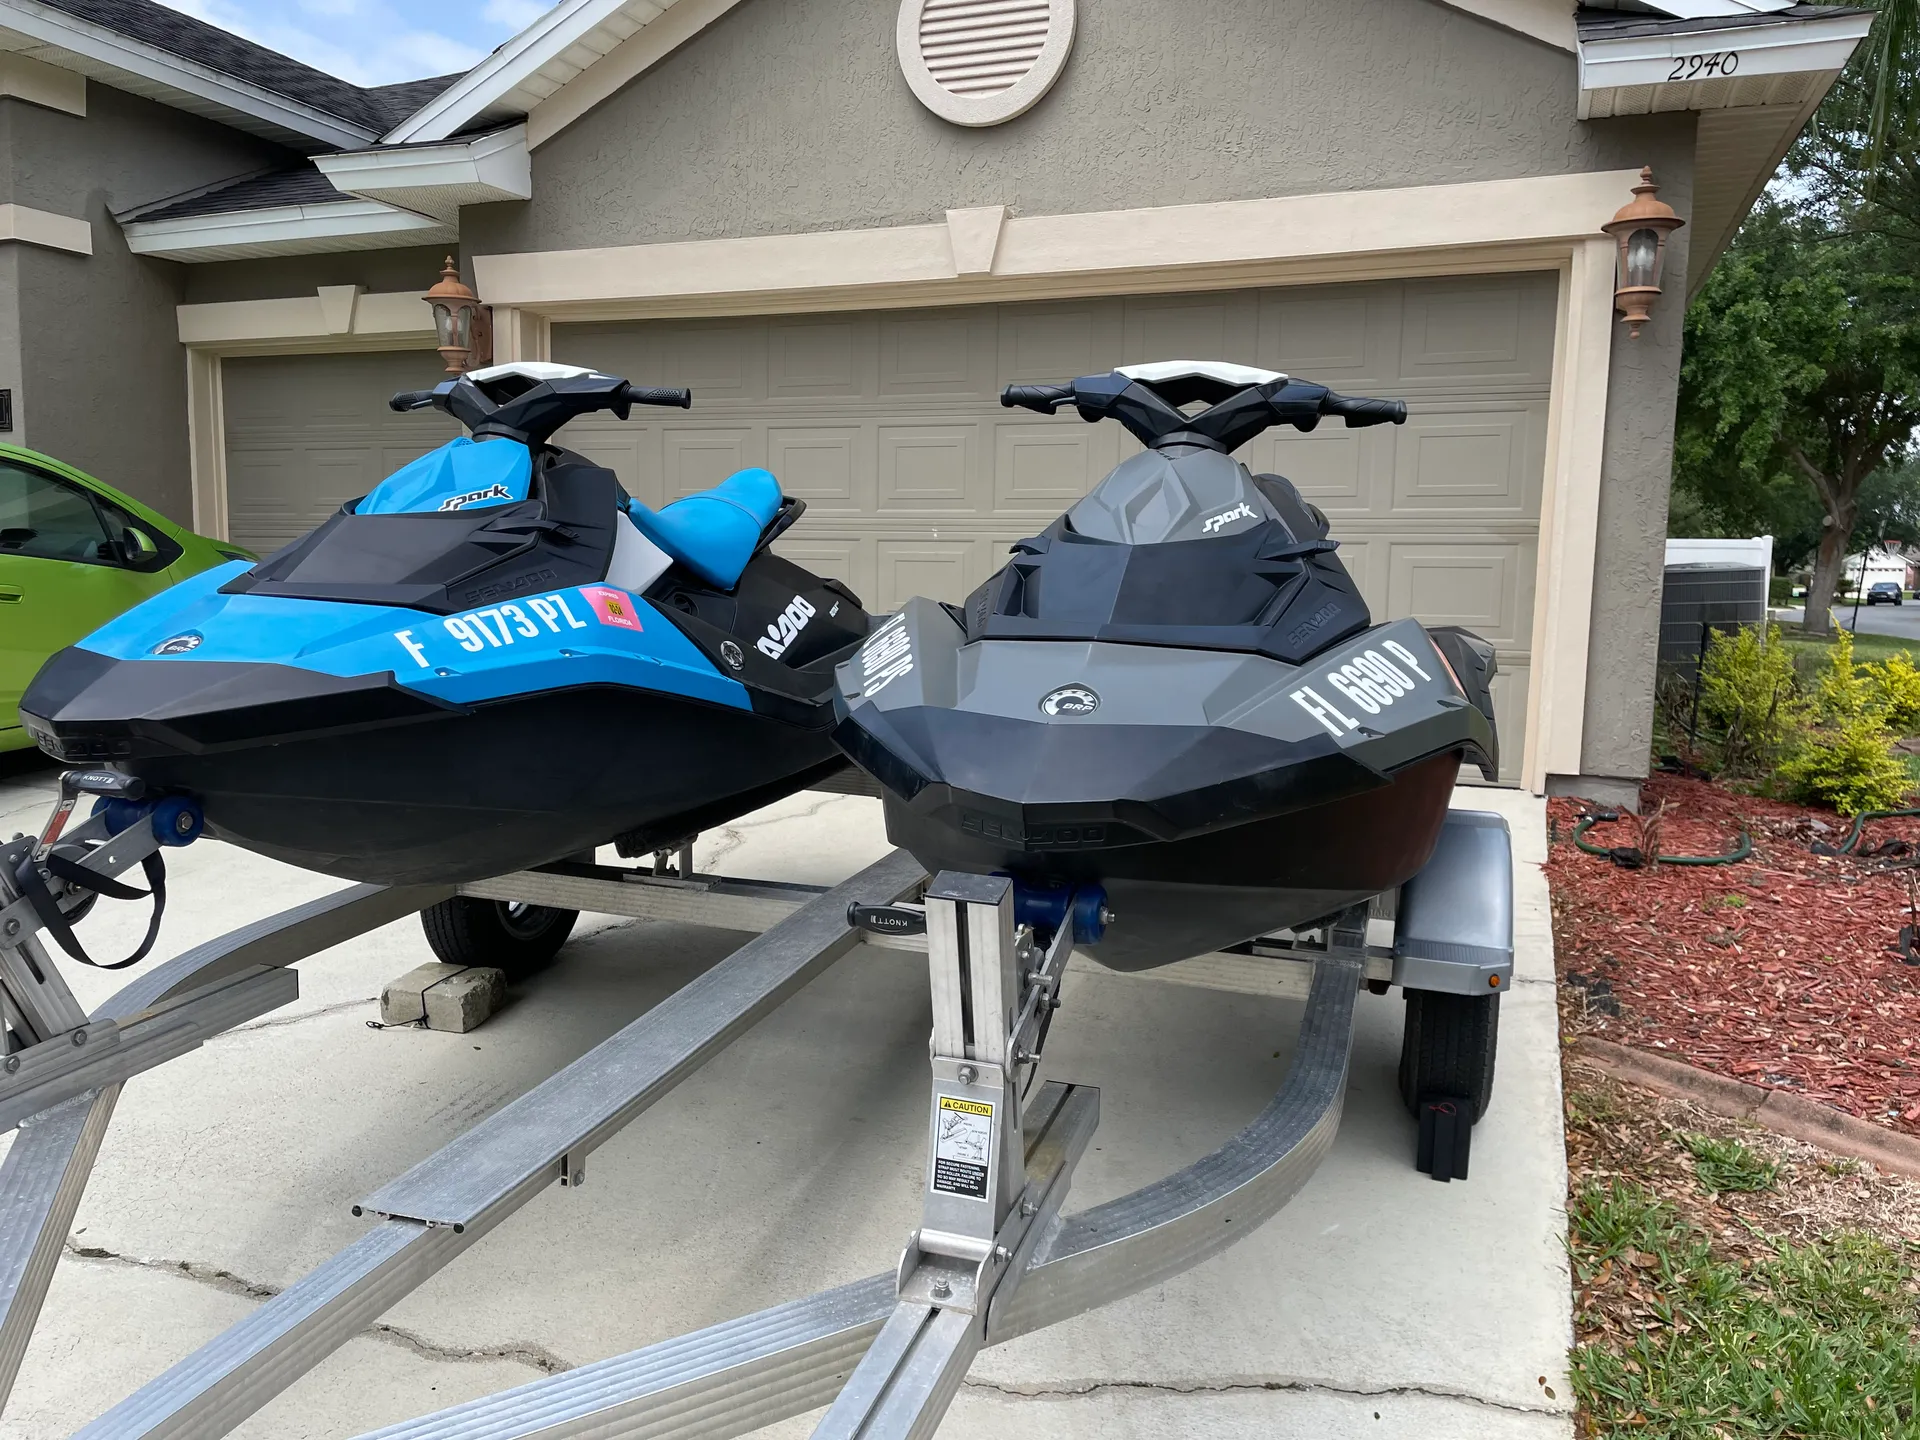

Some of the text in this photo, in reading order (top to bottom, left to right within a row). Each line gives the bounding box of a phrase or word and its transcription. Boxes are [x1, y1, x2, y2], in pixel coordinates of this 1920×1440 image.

[1667, 51, 1739, 82] 2940
[443, 604, 540, 653] 9173
[526, 594, 588, 633] PZ
[607, 615, 634, 627] FLORIDA
[861, 625, 911, 677] 6690
[863, 653, 914, 698] PS
[1289, 685, 1361, 738] FL
[1327, 650, 1416, 714] 6690
[1062, 702, 1094, 711] BRP
[82, 774, 109, 783] KNOTT
[877, 917, 908, 927] KNOTT
[952, 1101, 989, 1114] CAUTION
